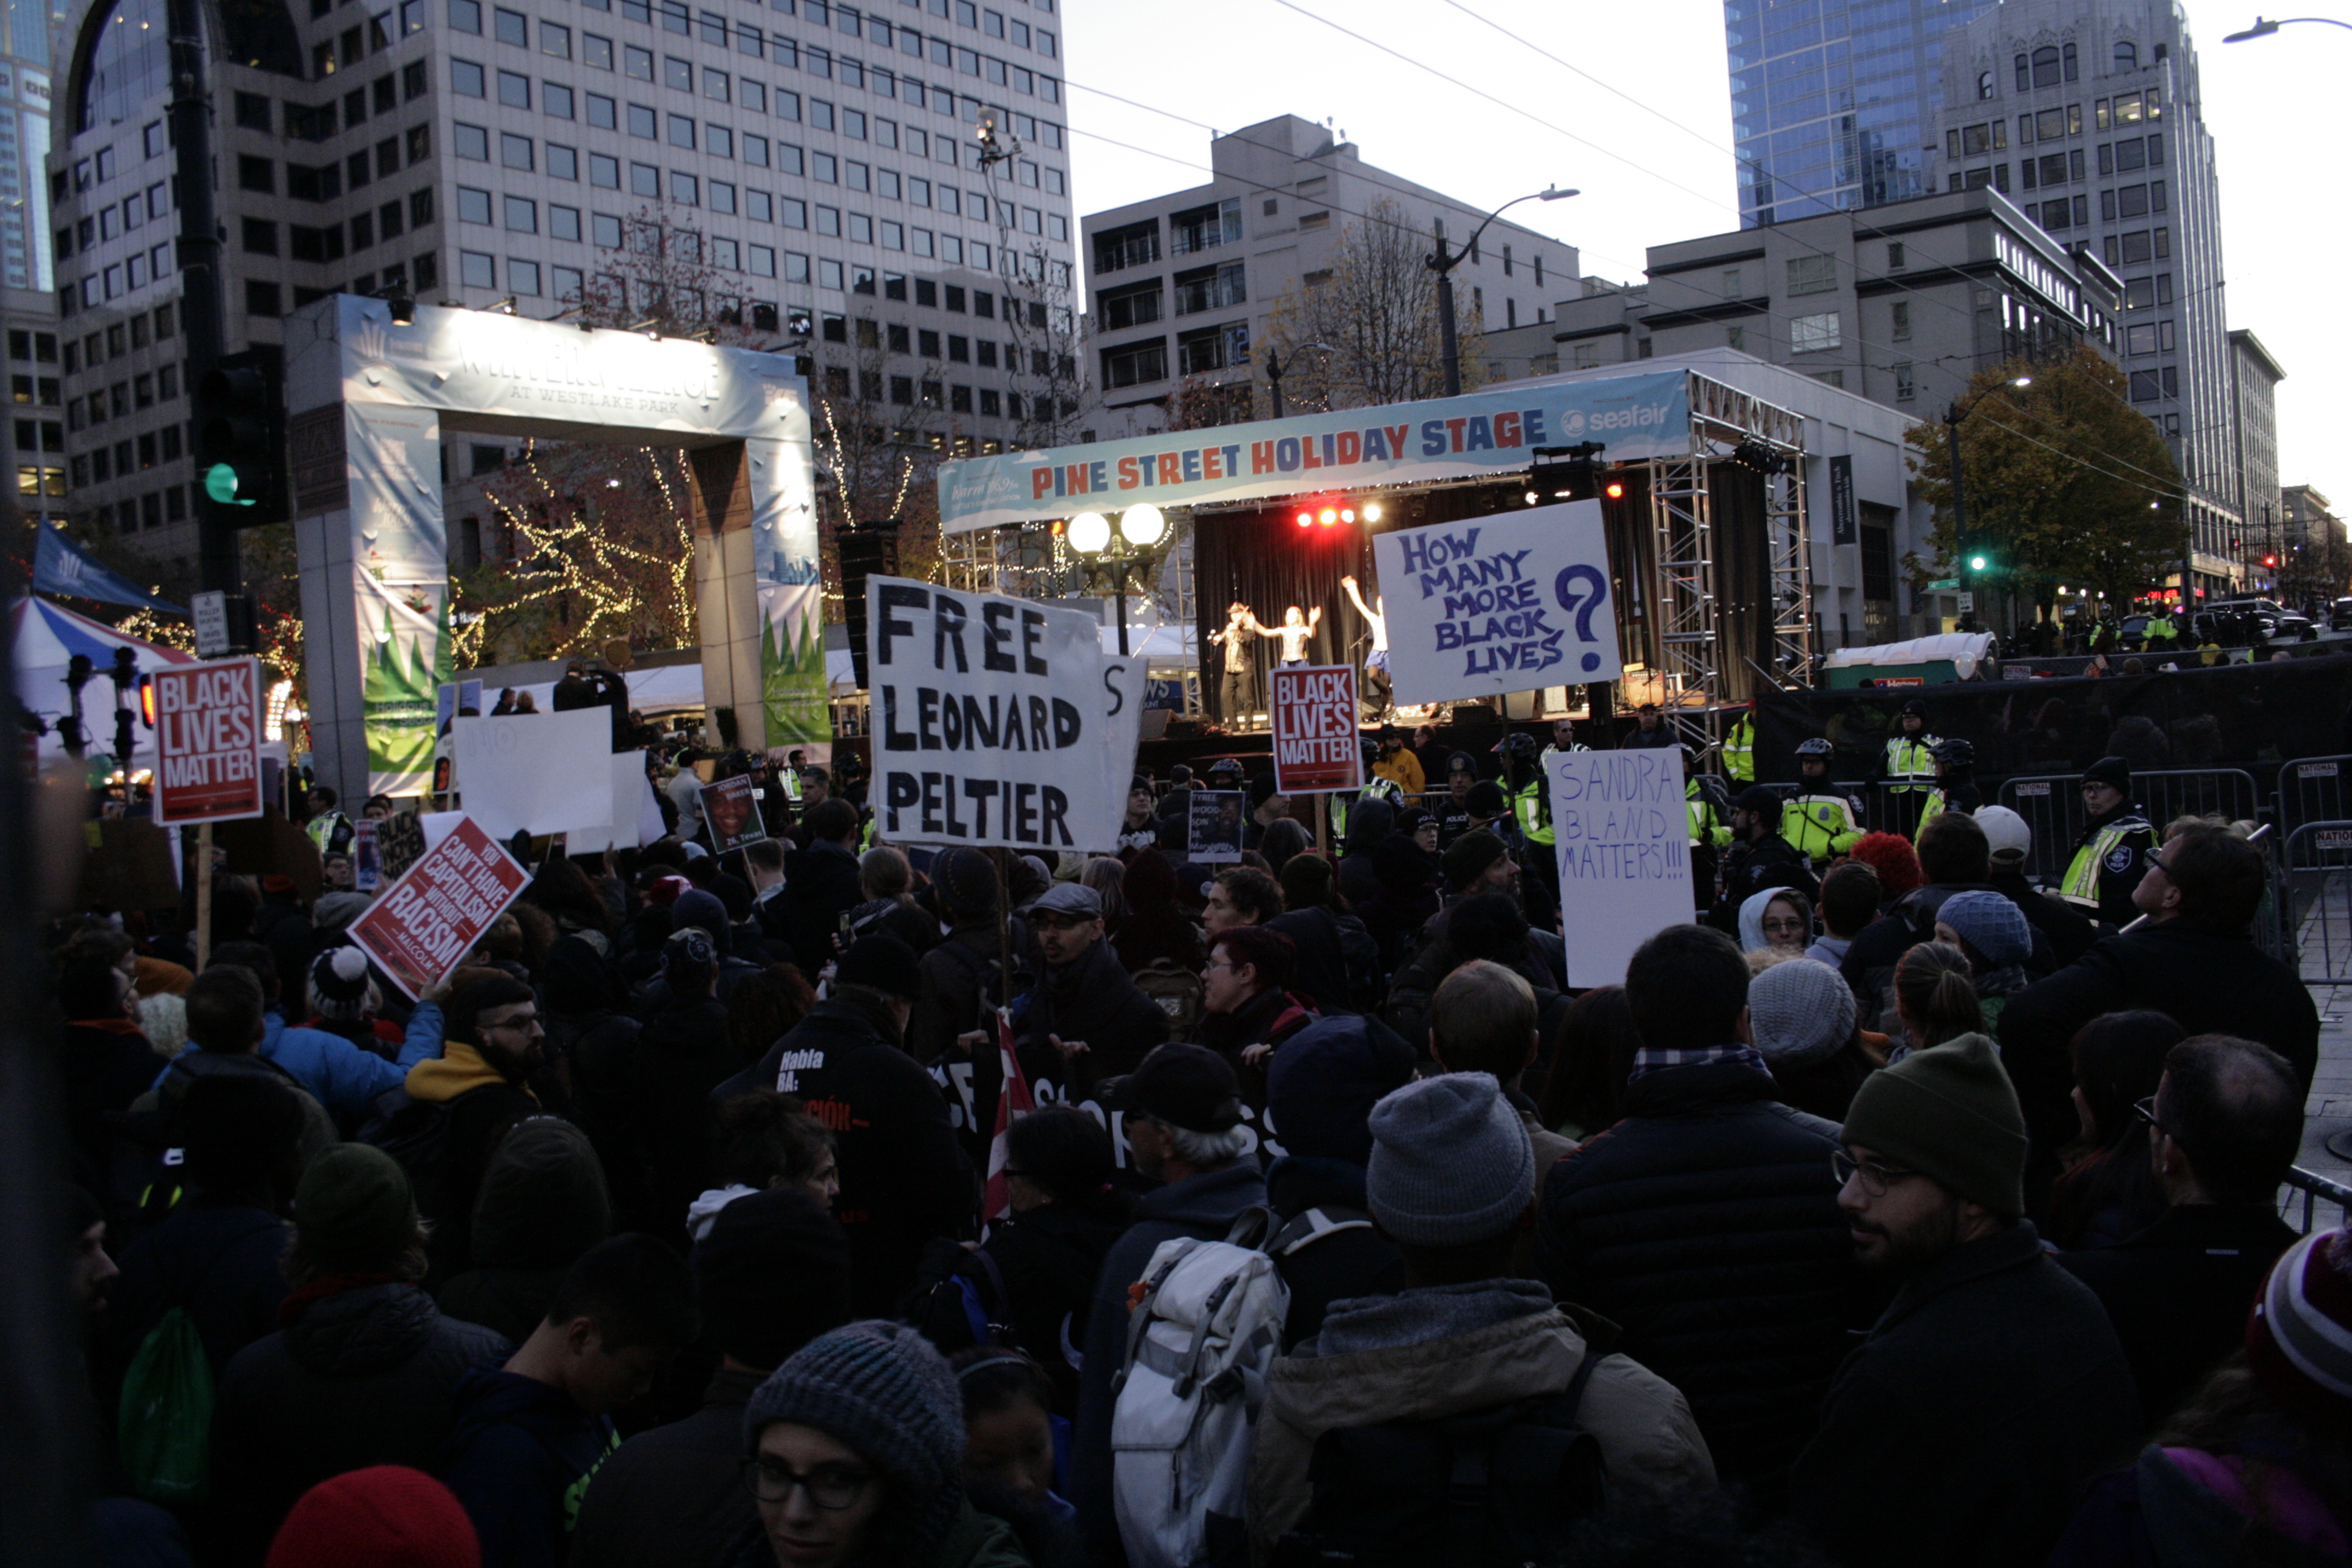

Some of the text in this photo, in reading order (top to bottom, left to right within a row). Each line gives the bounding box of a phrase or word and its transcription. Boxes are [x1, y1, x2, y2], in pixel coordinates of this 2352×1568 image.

[1225, 328, 1250, 364] 12
[511, 386, 679, 414] AT WESTLAKE PARK
[1590, 402, 1671, 431] seafair
[1031, 408, 1547, 500] PINE STREET HOLIDAY STAGE
[952, 484, 985, 501] Warm
[1836, 492, 1844, 535] Abercrombie
[1397, 528, 1481, 575] HOW
[1420, 549, 1532, 600] MANY
[1443, 578, 1541, 619] MORE
[878, 584, 1048, 676] FREE
[1435, 608, 1555, 652] BLACK
[1463, 629, 1565, 677] LIVES
[160, 668, 250, 714] BLACK
[1104, 665, 1125, 716] S
[1278, 673, 1349, 705] BLACK
[164, 705, 252, 756] LIVES
[881, 685, 1081, 751] LEONARD
[1279, 702, 1352, 739] LIVES
[165, 748, 254, 788] MATTER
[1281, 737, 1354, 765] MATTER
[2299, 763, 2336, 773] NATIONAL
[717, 778, 747, 792] JORDAN
[726, 788, 750, 800] BAKER
[1560, 754, 1676, 803] SANDRA
[887, 771, 1074, 846] PELTIER
[1192, 818, 1209, 826] SON
[1446, 815, 1468, 823] POLICE
[1566, 806, 1667, 840] BLAND
[480, 843, 501, 866] YOU
[740, 831, 762, 841] Texas
[441, 835, 510, 909] CAN'T HAVE
[1562, 840, 1683, 880] MATTERS!!!
[423, 854, 493, 928] CAPITALISM
[424, 885, 465, 927] WITHOUT
[385, 883, 465, 967] RACISM
[780, 1048, 824, 1072] Habla
